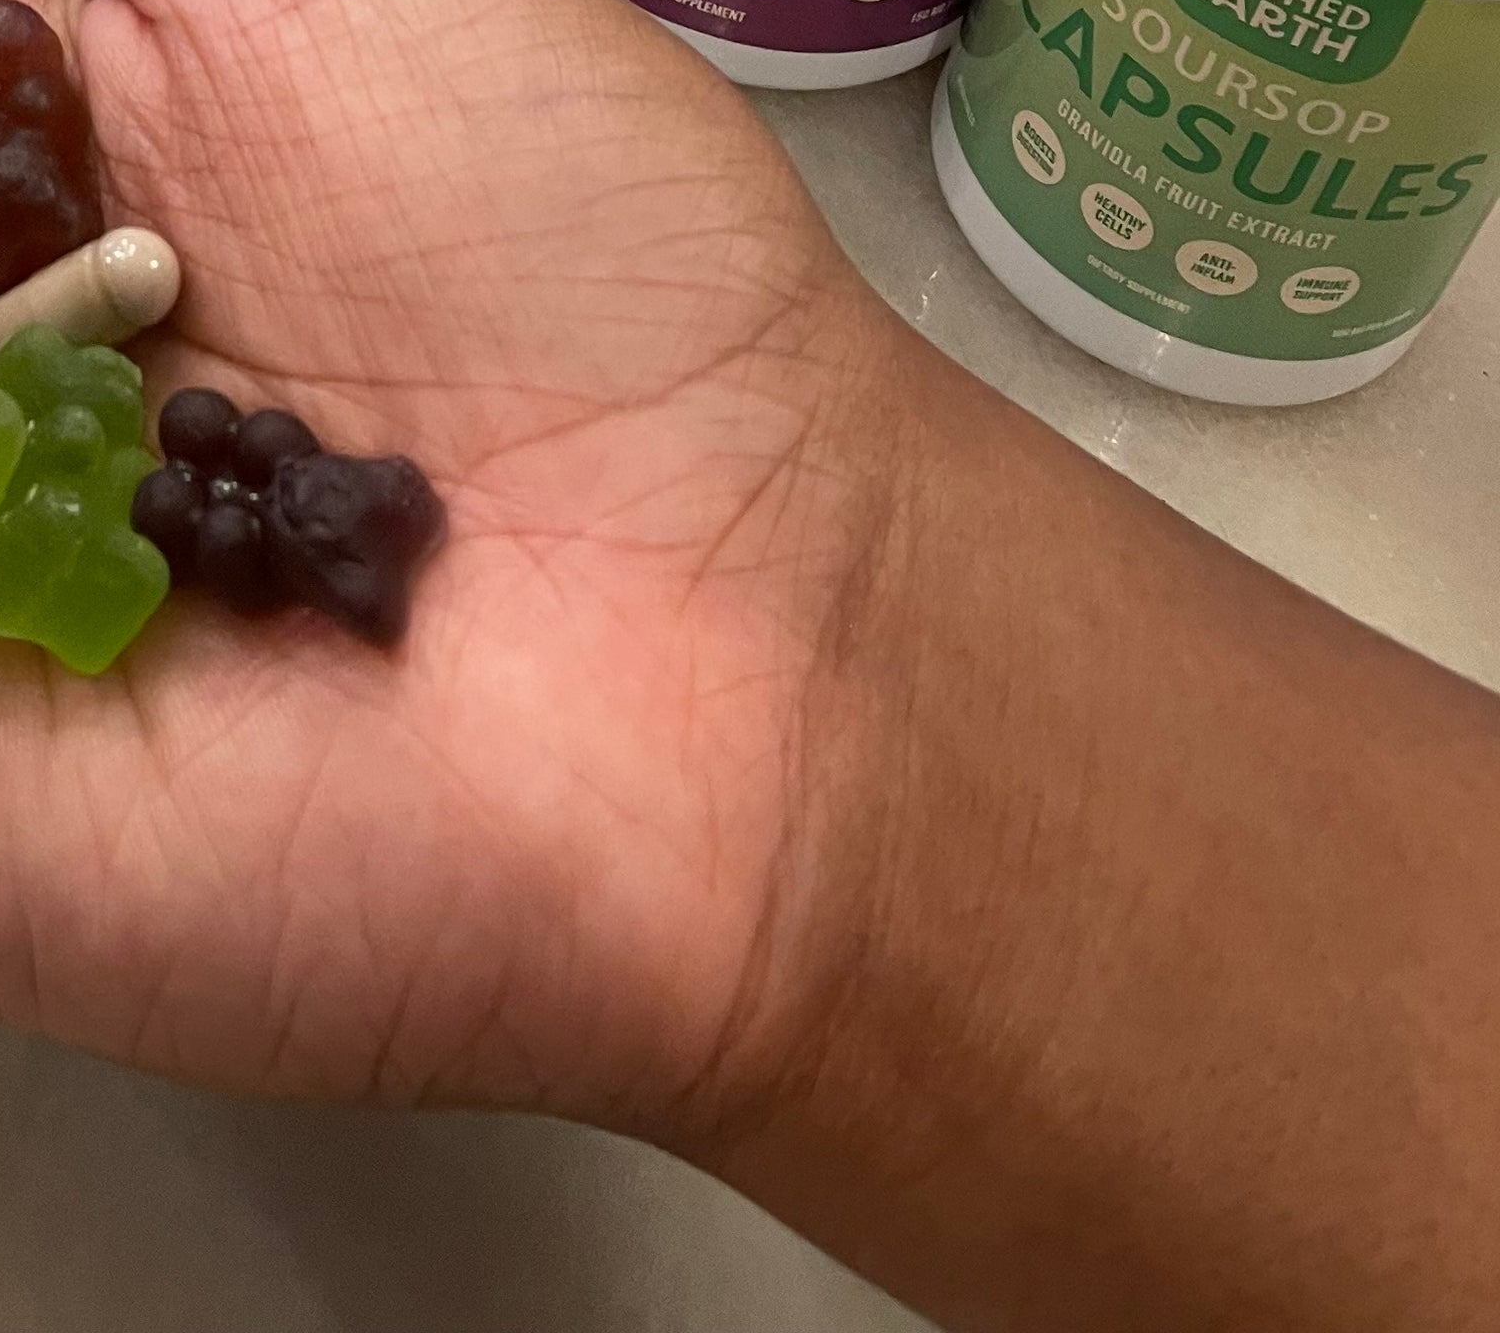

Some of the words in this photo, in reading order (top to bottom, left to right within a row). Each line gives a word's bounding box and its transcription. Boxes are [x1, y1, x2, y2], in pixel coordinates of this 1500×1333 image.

[1056, 97, 1149, 186] GRAVIOLA
[1153, 175, 1223, 222] FRUIT
[1226, 210, 1338, 252] EXTRACT
[1093, 190, 1148, 233] HEALTHY
[1094, 208, 1134, 242] CELLS
[1198, 251, 1237, 272] ANTI-
